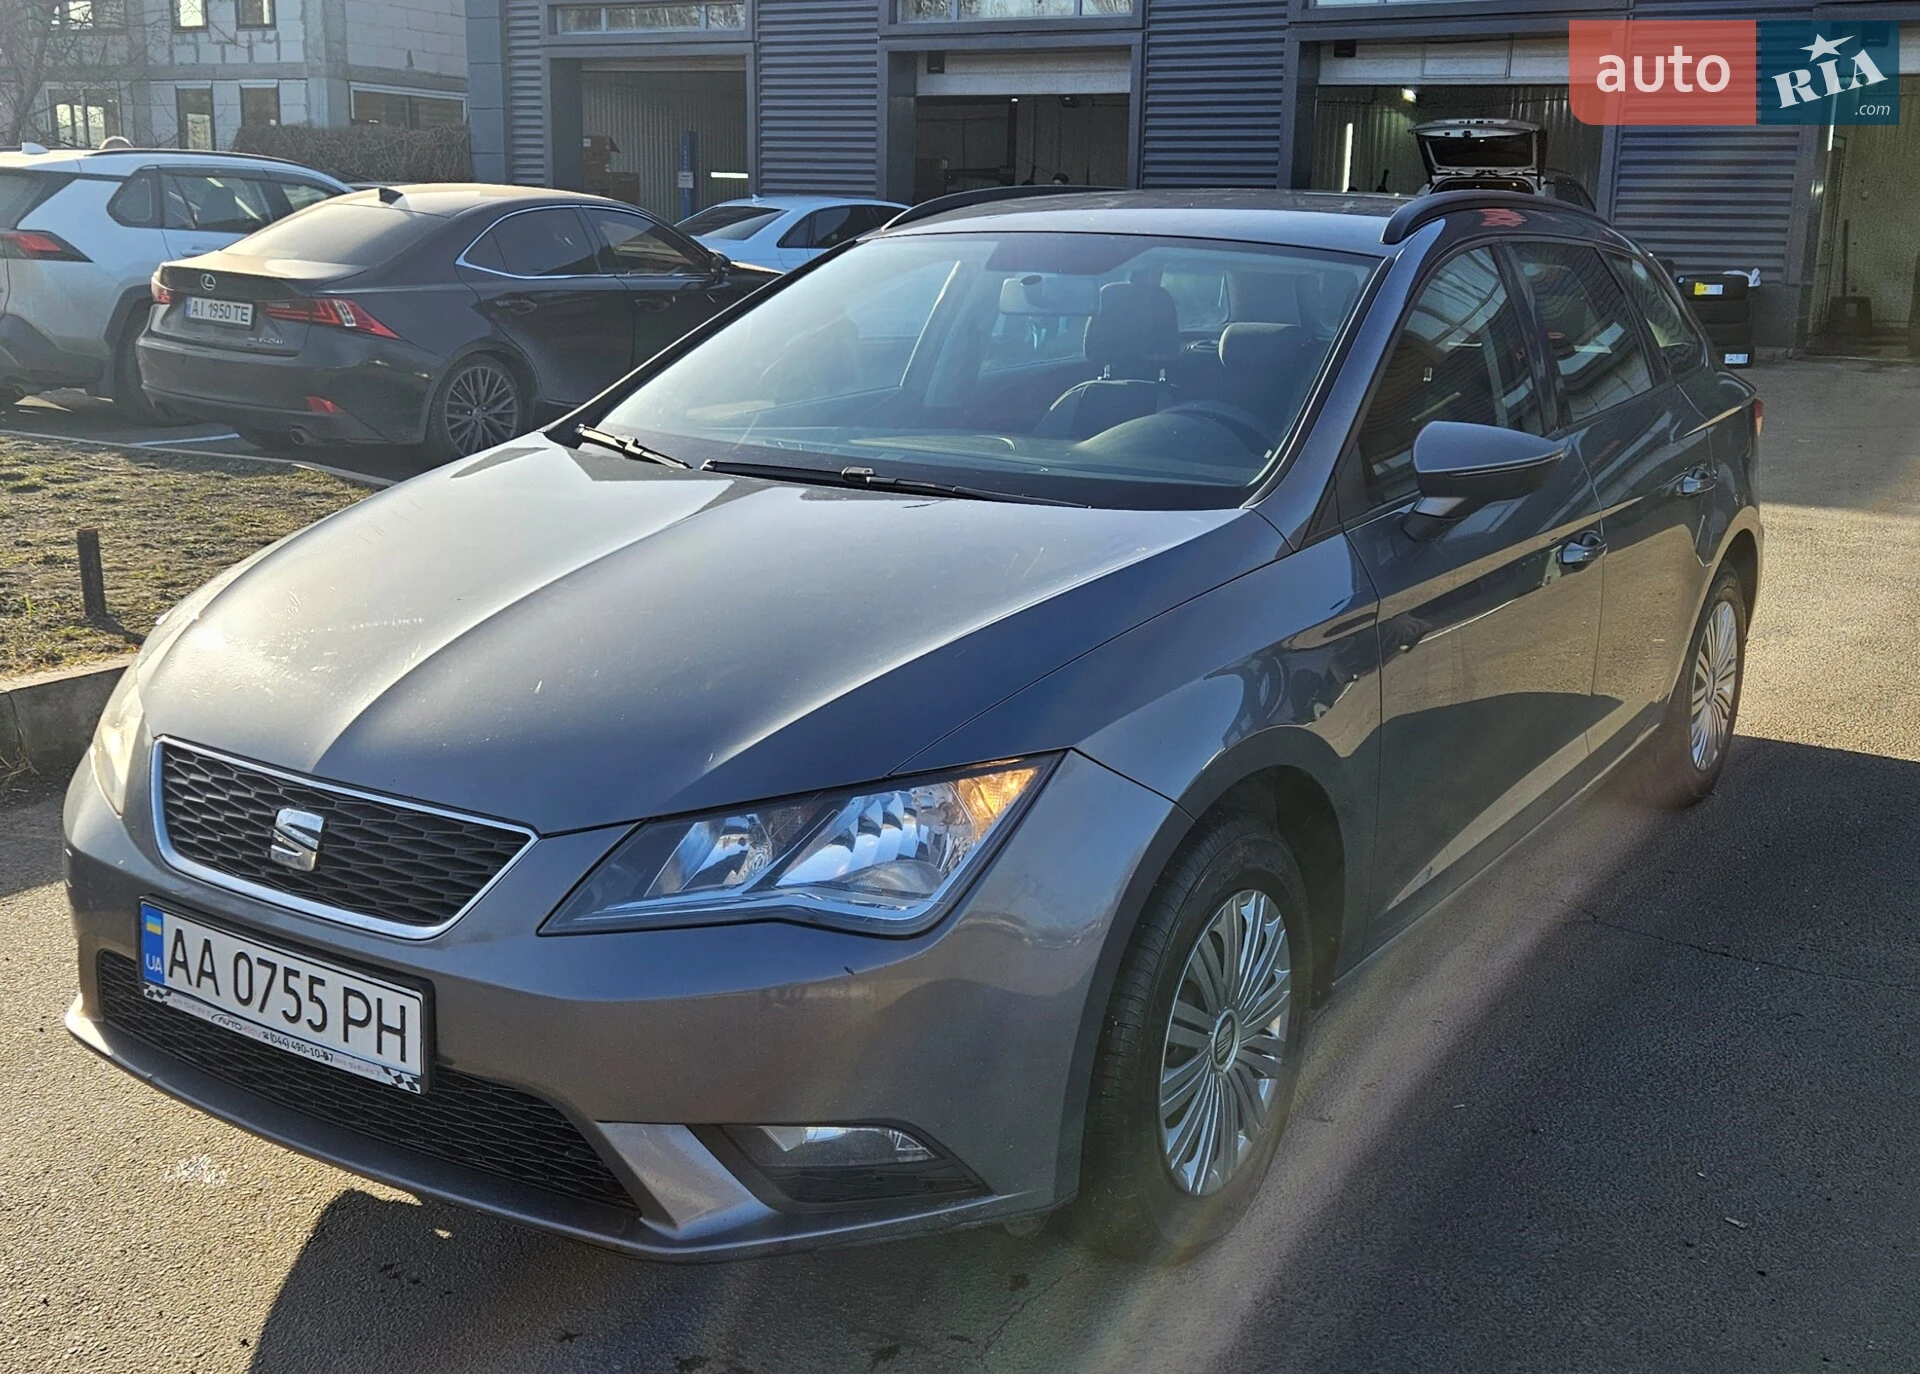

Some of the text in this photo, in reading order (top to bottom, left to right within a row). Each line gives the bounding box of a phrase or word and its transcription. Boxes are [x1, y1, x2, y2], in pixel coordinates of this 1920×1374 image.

[208, 303, 231, 320] 1950
[233, 306, 249, 323] TE
[146, 953, 162, 974] UA
[168, 928, 407, 1063] AA 0755 PH
